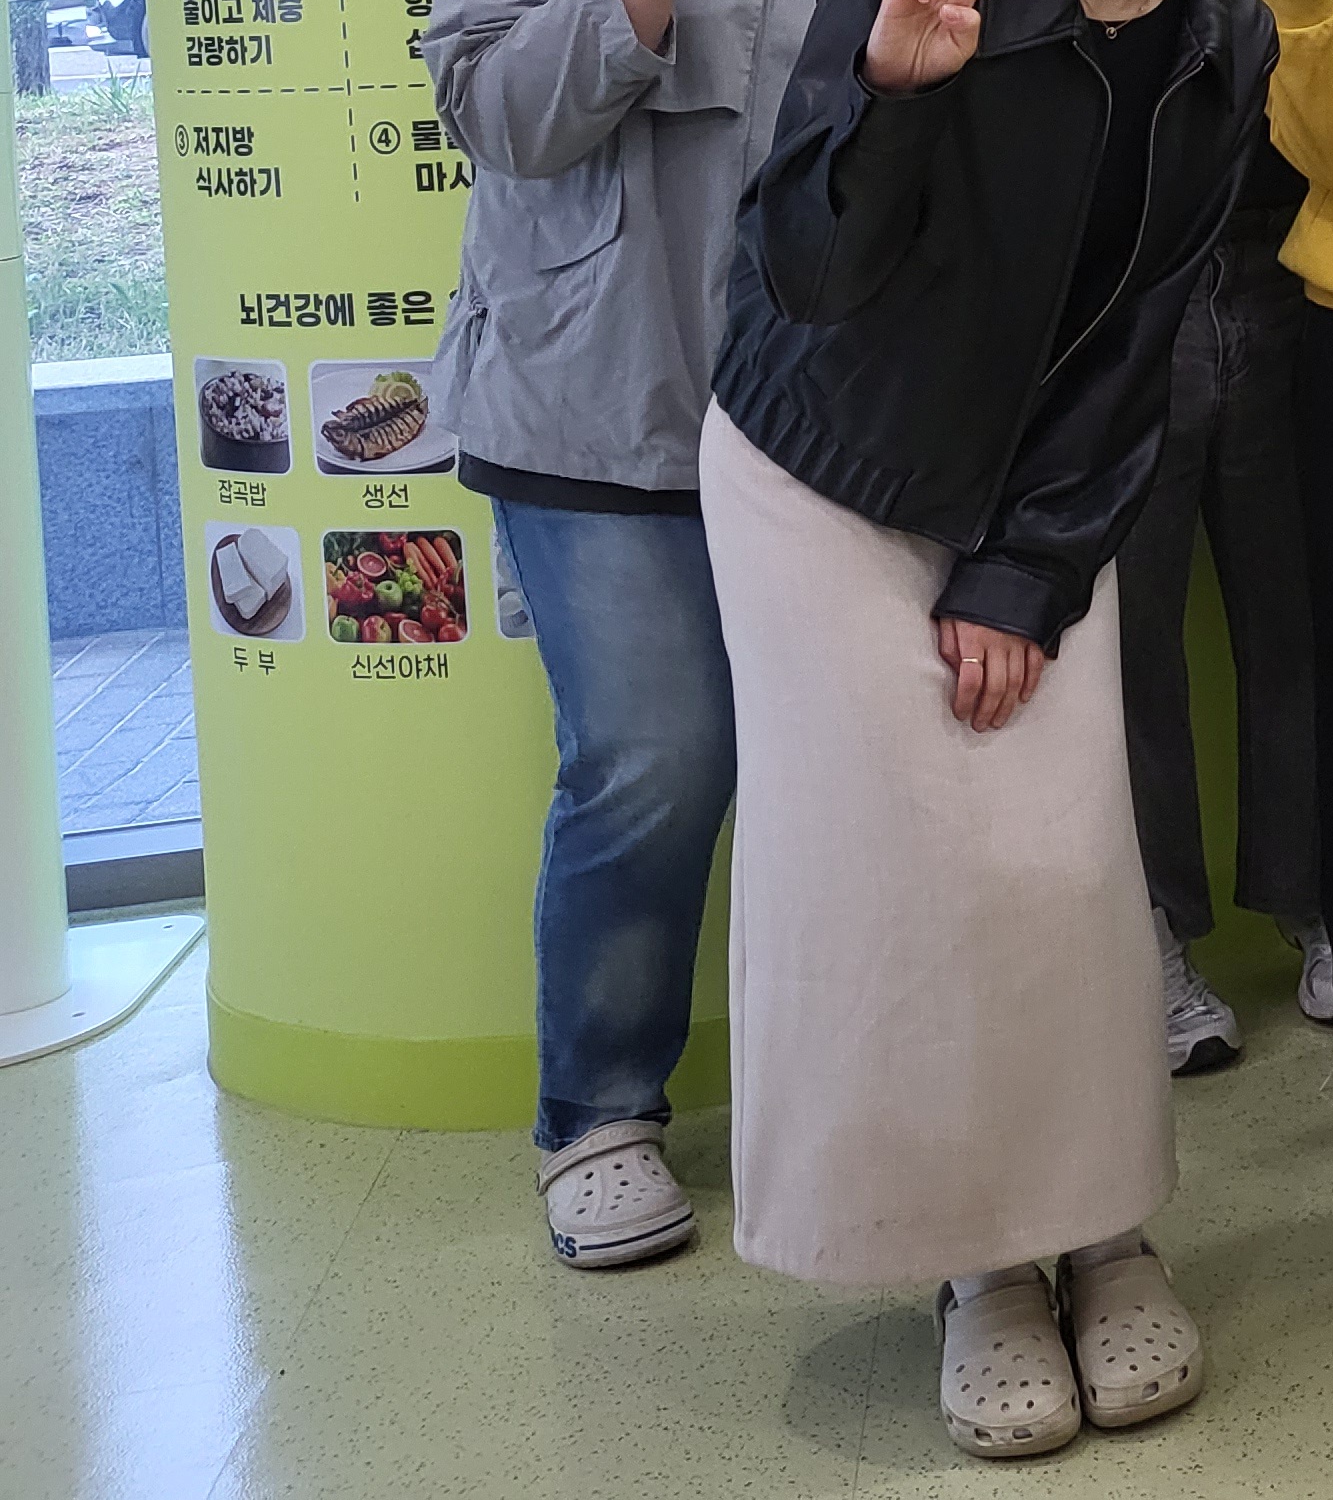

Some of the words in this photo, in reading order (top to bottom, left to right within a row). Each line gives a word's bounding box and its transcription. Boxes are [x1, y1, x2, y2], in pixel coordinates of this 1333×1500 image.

[186, 35, 273, 67] 감량하기
[193, 125, 255, 157] 저지방
[195, 167, 282, 199] 식사하기
[239, 292, 355, 328] 뇌건강에
[367, 290, 436, 326] 좋은
[217, 480, 267, 508] 잡곡밥
[362, 483, 411, 510] 생선
[351, 653, 449, 680] 신선야채
